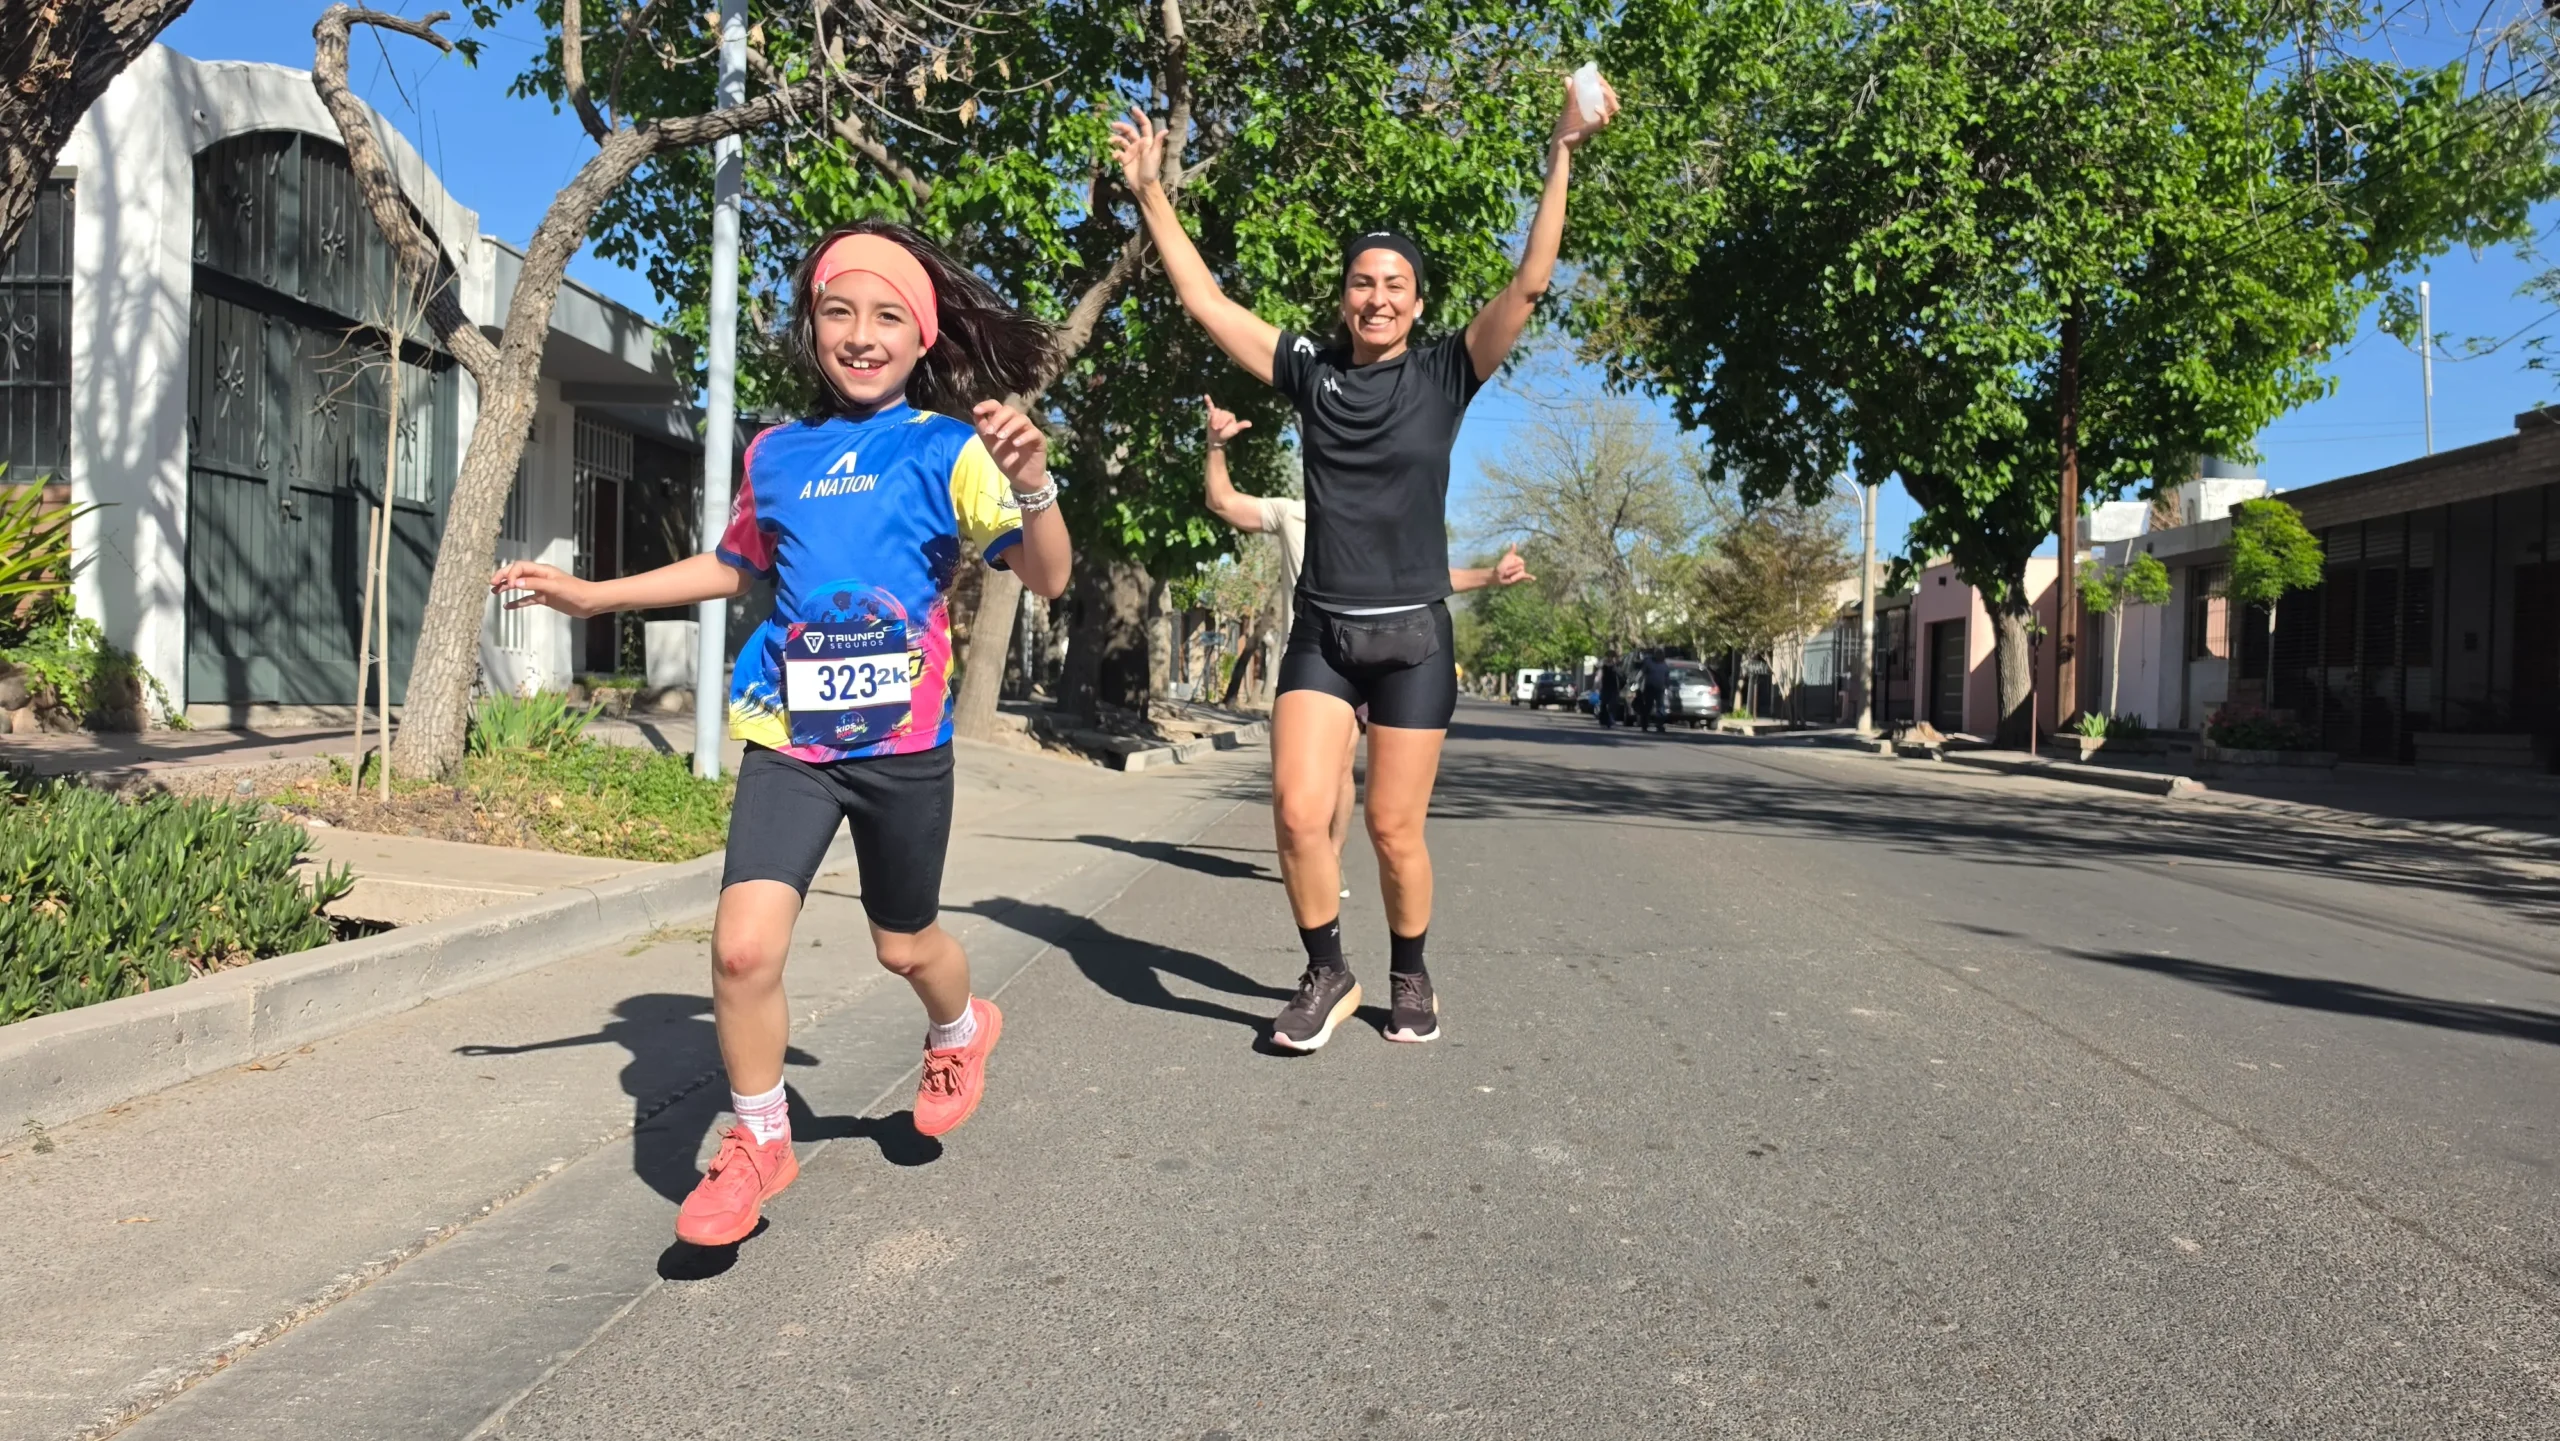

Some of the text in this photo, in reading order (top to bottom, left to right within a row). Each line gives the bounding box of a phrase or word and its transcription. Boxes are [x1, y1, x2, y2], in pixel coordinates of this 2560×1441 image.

[799, 474, 879, 500] A NATION
[827, 631, 885, 643] TRIUNFO
[830, 639, 884, 650] SEGUROS
[818, 663, 877, 701] 323
[835, 722, 856, 734] KIDS
